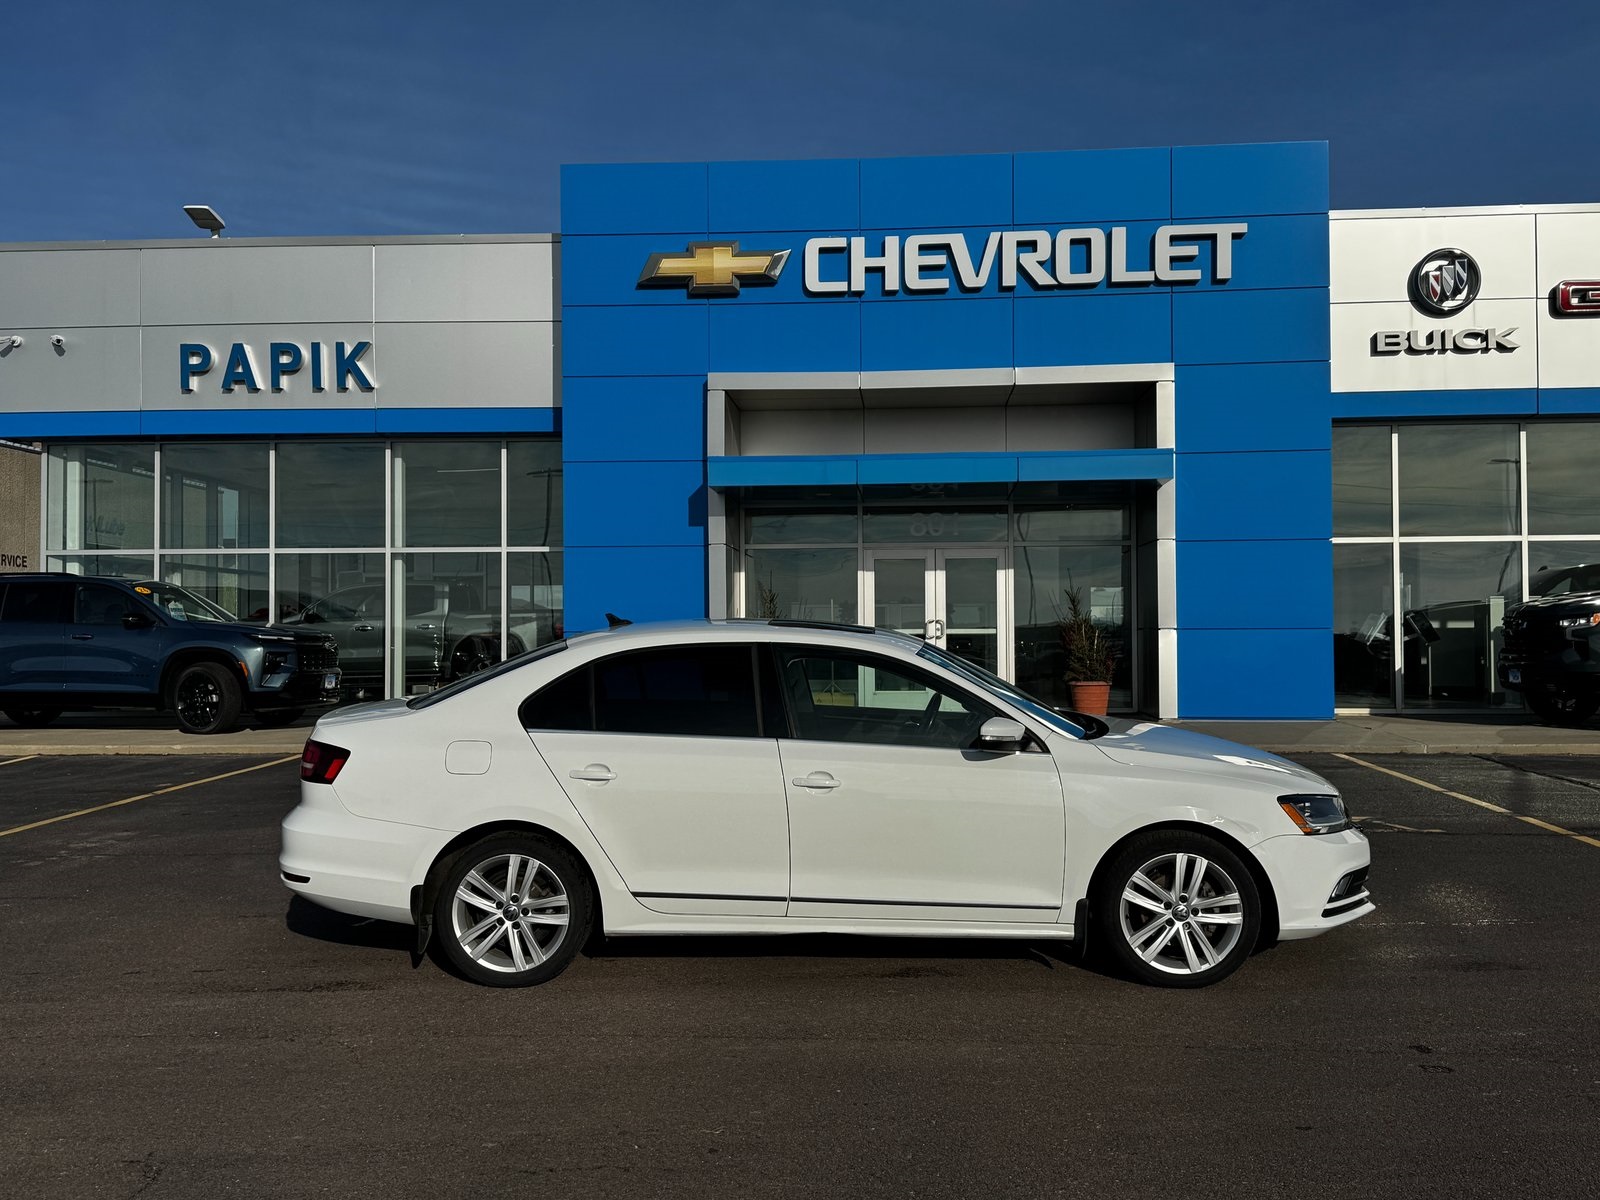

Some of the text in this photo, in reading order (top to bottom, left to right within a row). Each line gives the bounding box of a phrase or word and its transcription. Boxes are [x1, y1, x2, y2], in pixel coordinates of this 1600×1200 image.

[804, 223, 1248, 294] CHEVROLET
[1371, 327, 1520, 356] BUICK
[180, 341, 375, 393] PAPIK
[1, 554, 28, 568] RVICE
